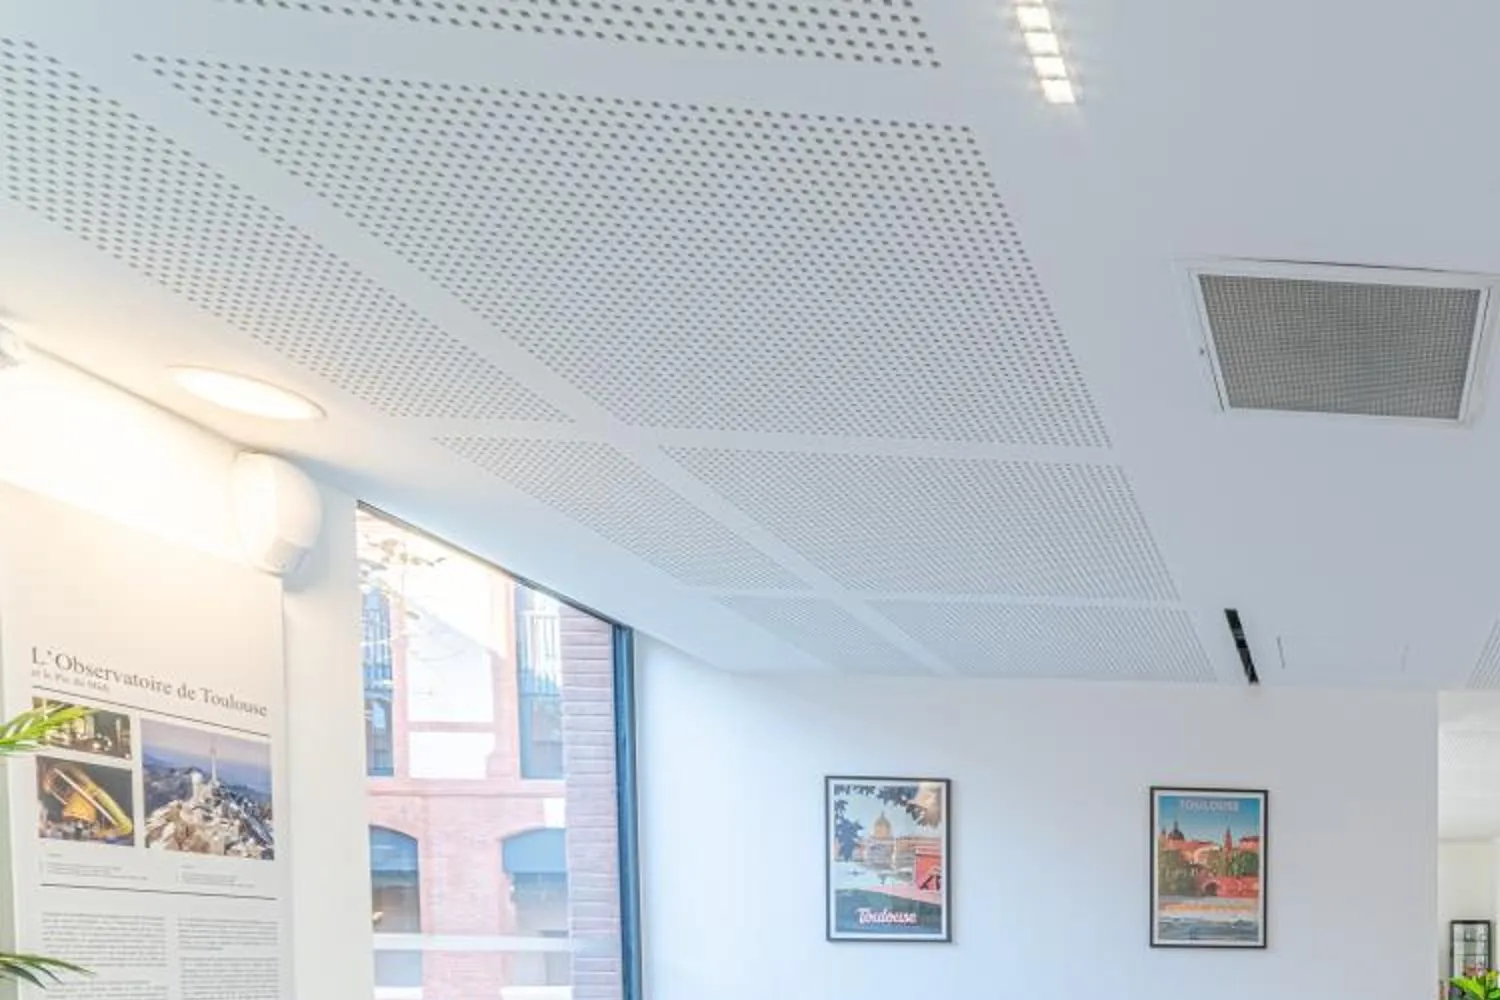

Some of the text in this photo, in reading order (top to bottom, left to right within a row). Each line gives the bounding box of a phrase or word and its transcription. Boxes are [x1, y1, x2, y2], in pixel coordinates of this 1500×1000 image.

[31, 646, 268, 717] L'Observatoire de Toulouse
[1180, 799, 1239, 812] TOULOUSE
[856, 907, 917, 925] Toulouse
